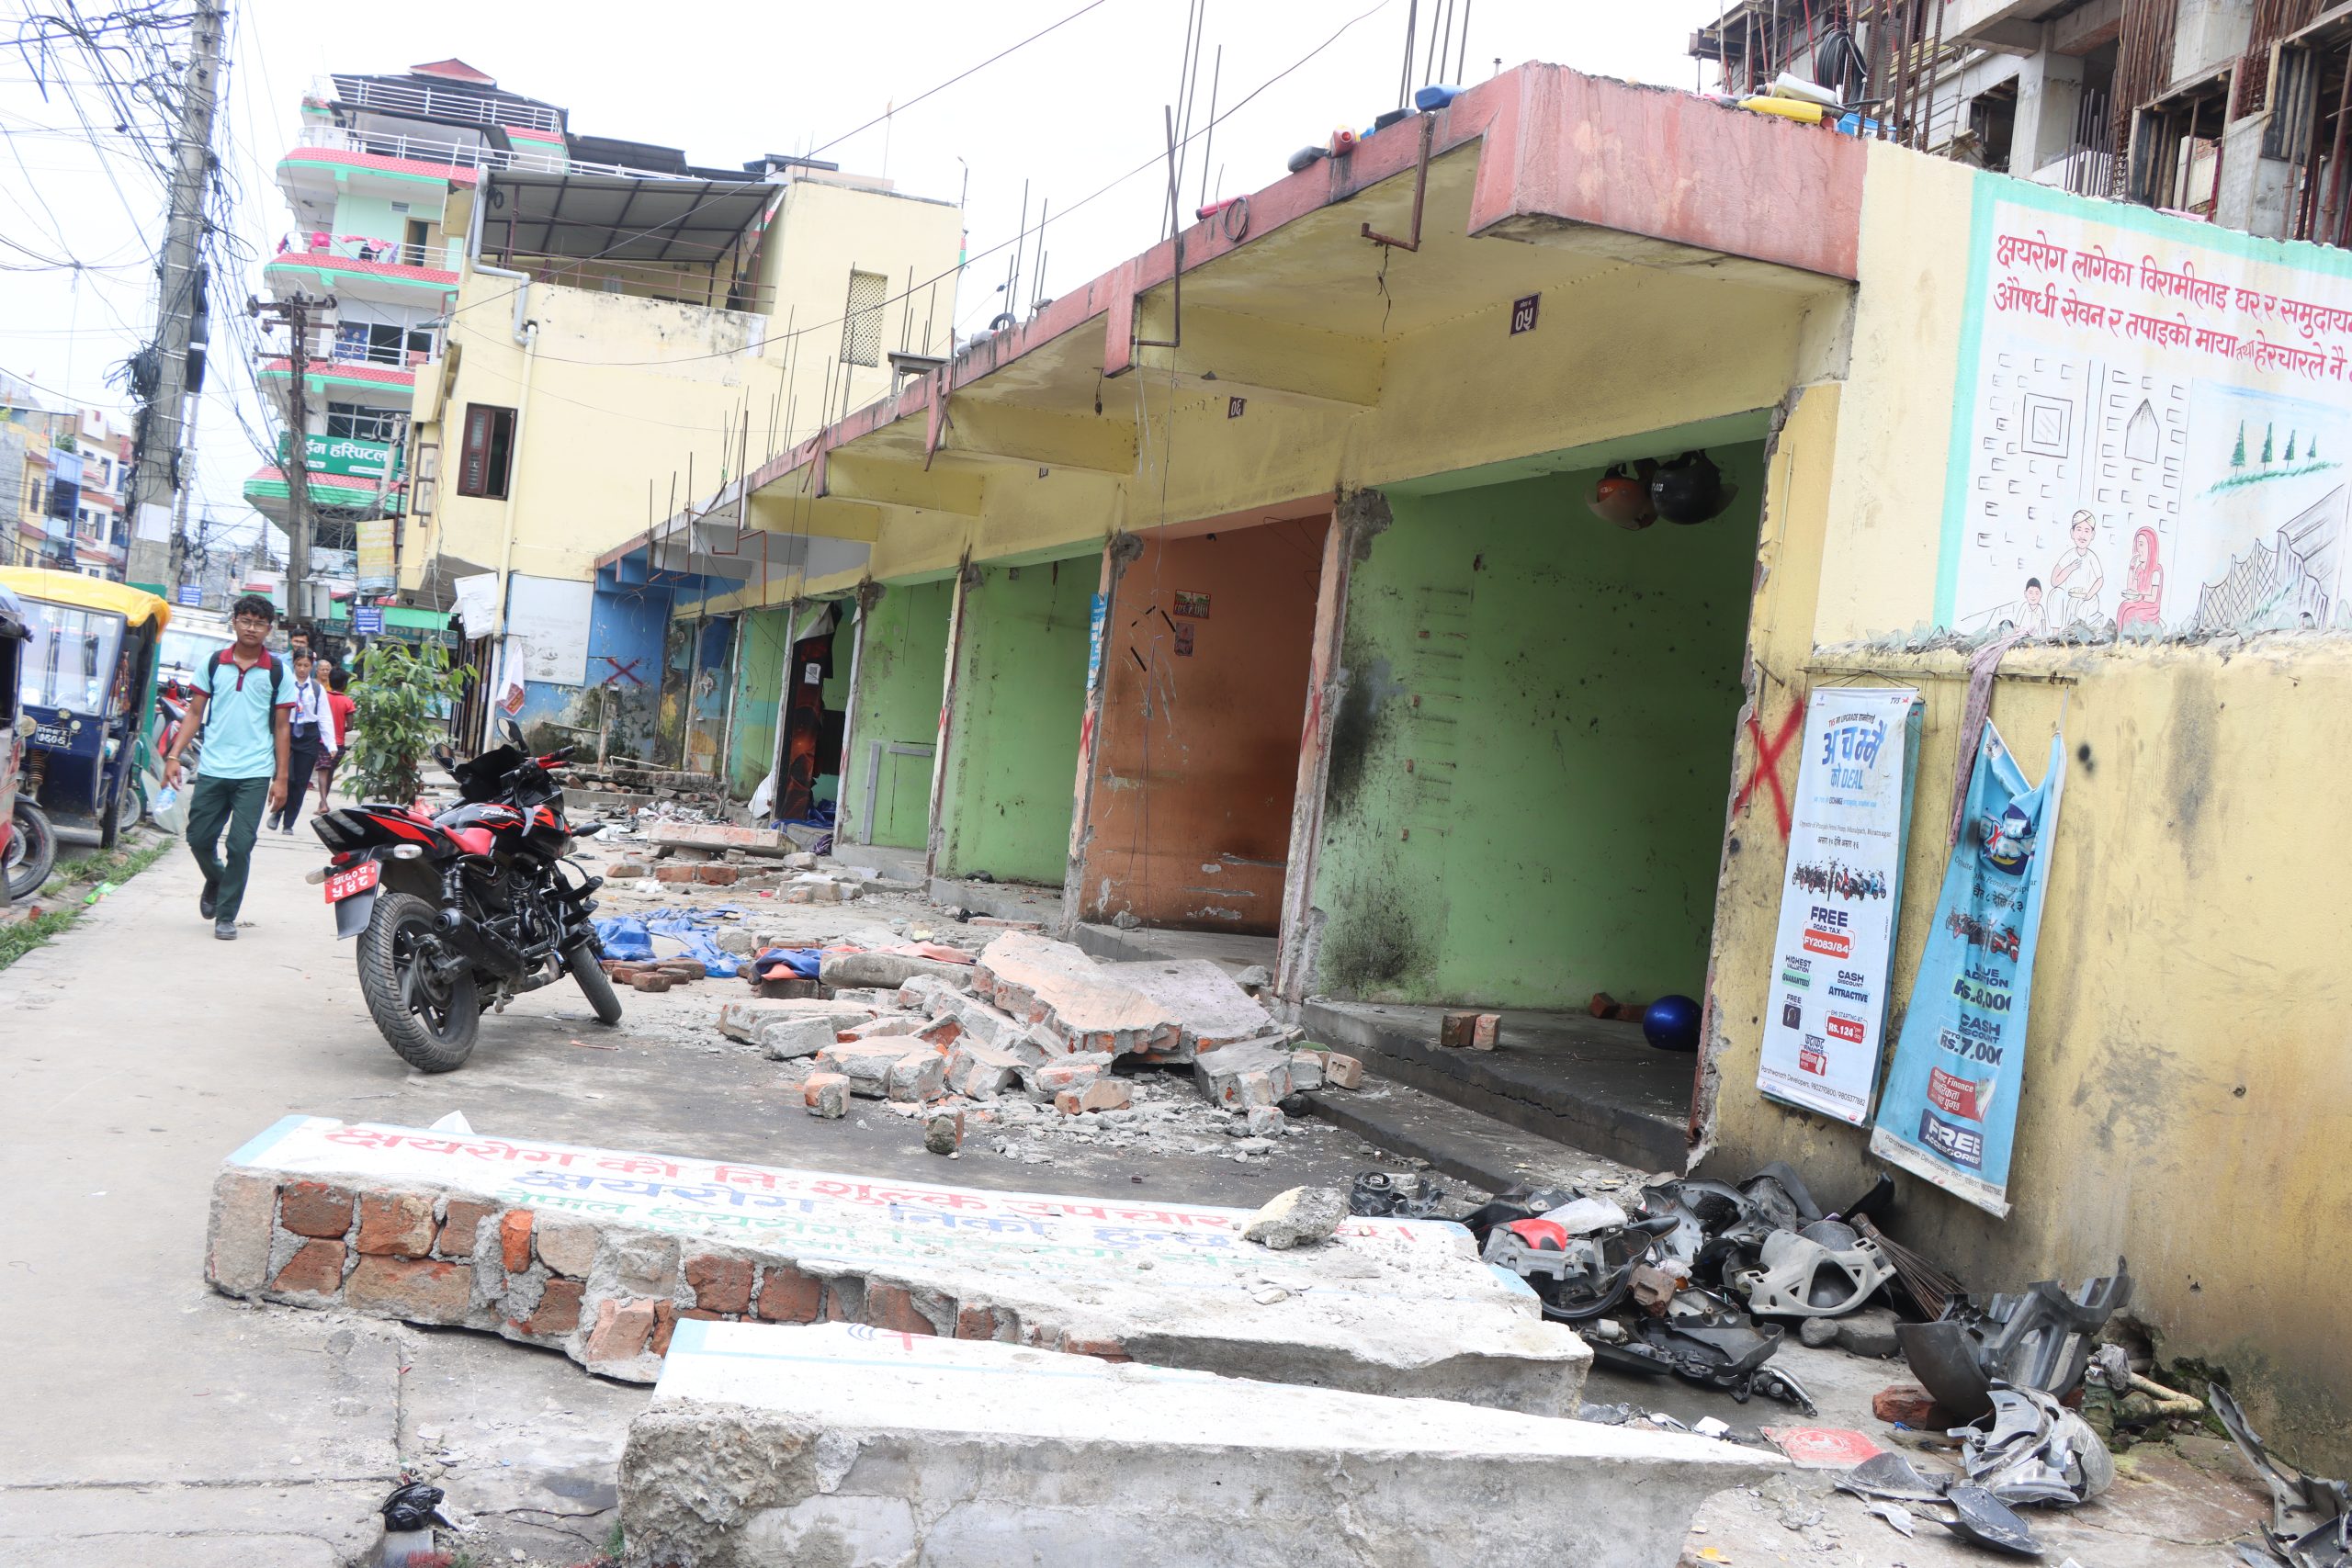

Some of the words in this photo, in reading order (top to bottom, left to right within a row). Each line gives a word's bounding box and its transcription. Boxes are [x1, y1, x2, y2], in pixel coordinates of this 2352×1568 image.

[1997, 230, 2068, 274] क्षयरोग
[2072, 244, 2134, 287] लागेका
[2234, 288, 2262, 323] घर
[2264, 295, 2278, 321] र
[1994, 276, 2059, 319] औषधी
[2061, 288, 2106, 328] सेवन
[2109, 309, 2124, 337] र
[2126, 312, 2191, 351] तपाइको
[2195, 328, 2239, 358] माया
[2236, 340, 2256, 361] तथा
[2329, 345, 2348, 380] नै
[1841, 769, 1863, 790] DEAL
[1810, 906, 1849, 928] FREE
[1813, 923, 1827, 931] ROAD
[1828, 926, 1841, 935] TAX
[1804, 935, 1849, 954] FY2083/84
[1785, 954, 1812, 968] HIGHEST
[1786, 963, 1810, 974] VALUATION
[1837, 978, 1863, 988] DISCOUNT
[1838, 970, 1864, 983] CASH
[1786, 993, 1802, 1004] FREE
[1838, 1011, 1856, 1021] STARTING
[1961, 1012, 2001, 1036] CASH
[1942, 1028, 1961, 1040] UPTO
[1958, 1025, 1999, 1043] DISCOUNT
[1804, 1044, 1825, 1056] FINANCE
[1947, 1077, 1974, 1093] Finance
[1928, 1117, 1981, 1156] FREE
[1925, 1134, 1979, 1164] ACCESSORIES
[324, 1128, 586, 1167] क्षयरोग
[596, 1156, 682, 1179] को
[1001, 1199, 1232, 1225] उपचार
[513, 1170, 834, 1213] क्षयरोग
[888, 1204, 1058, 1236] निको
